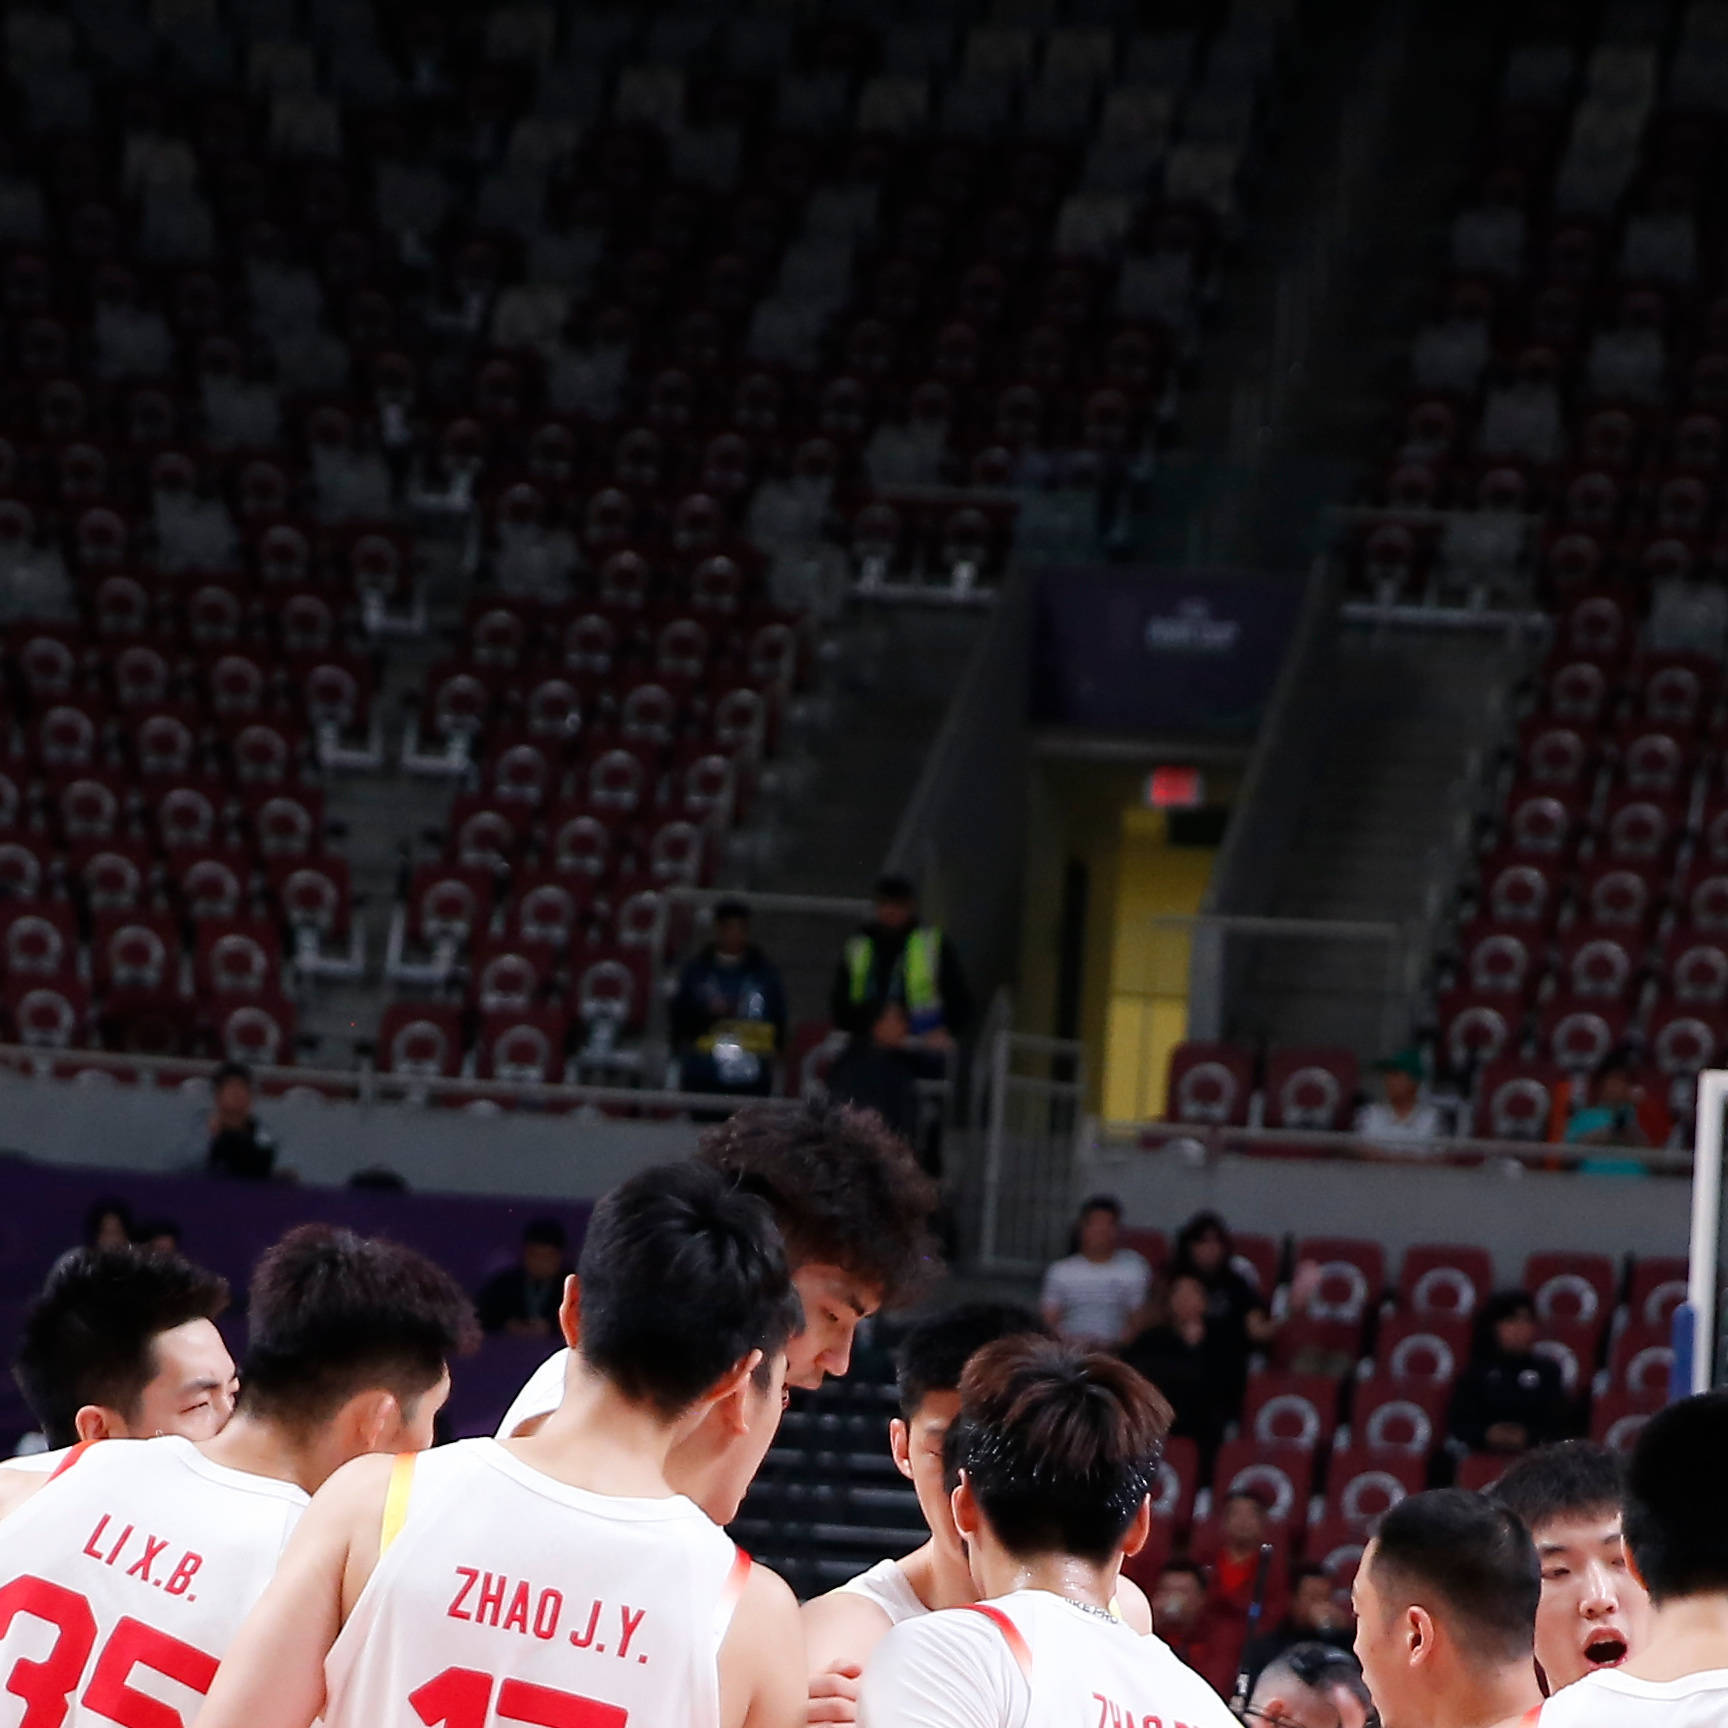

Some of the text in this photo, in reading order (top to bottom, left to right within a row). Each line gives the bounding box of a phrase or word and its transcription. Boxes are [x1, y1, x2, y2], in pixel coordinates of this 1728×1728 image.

[82, 1513, 204, 1603] LI X.B.
[447, 1565, 649, 1665] ZHAO J.Y.
